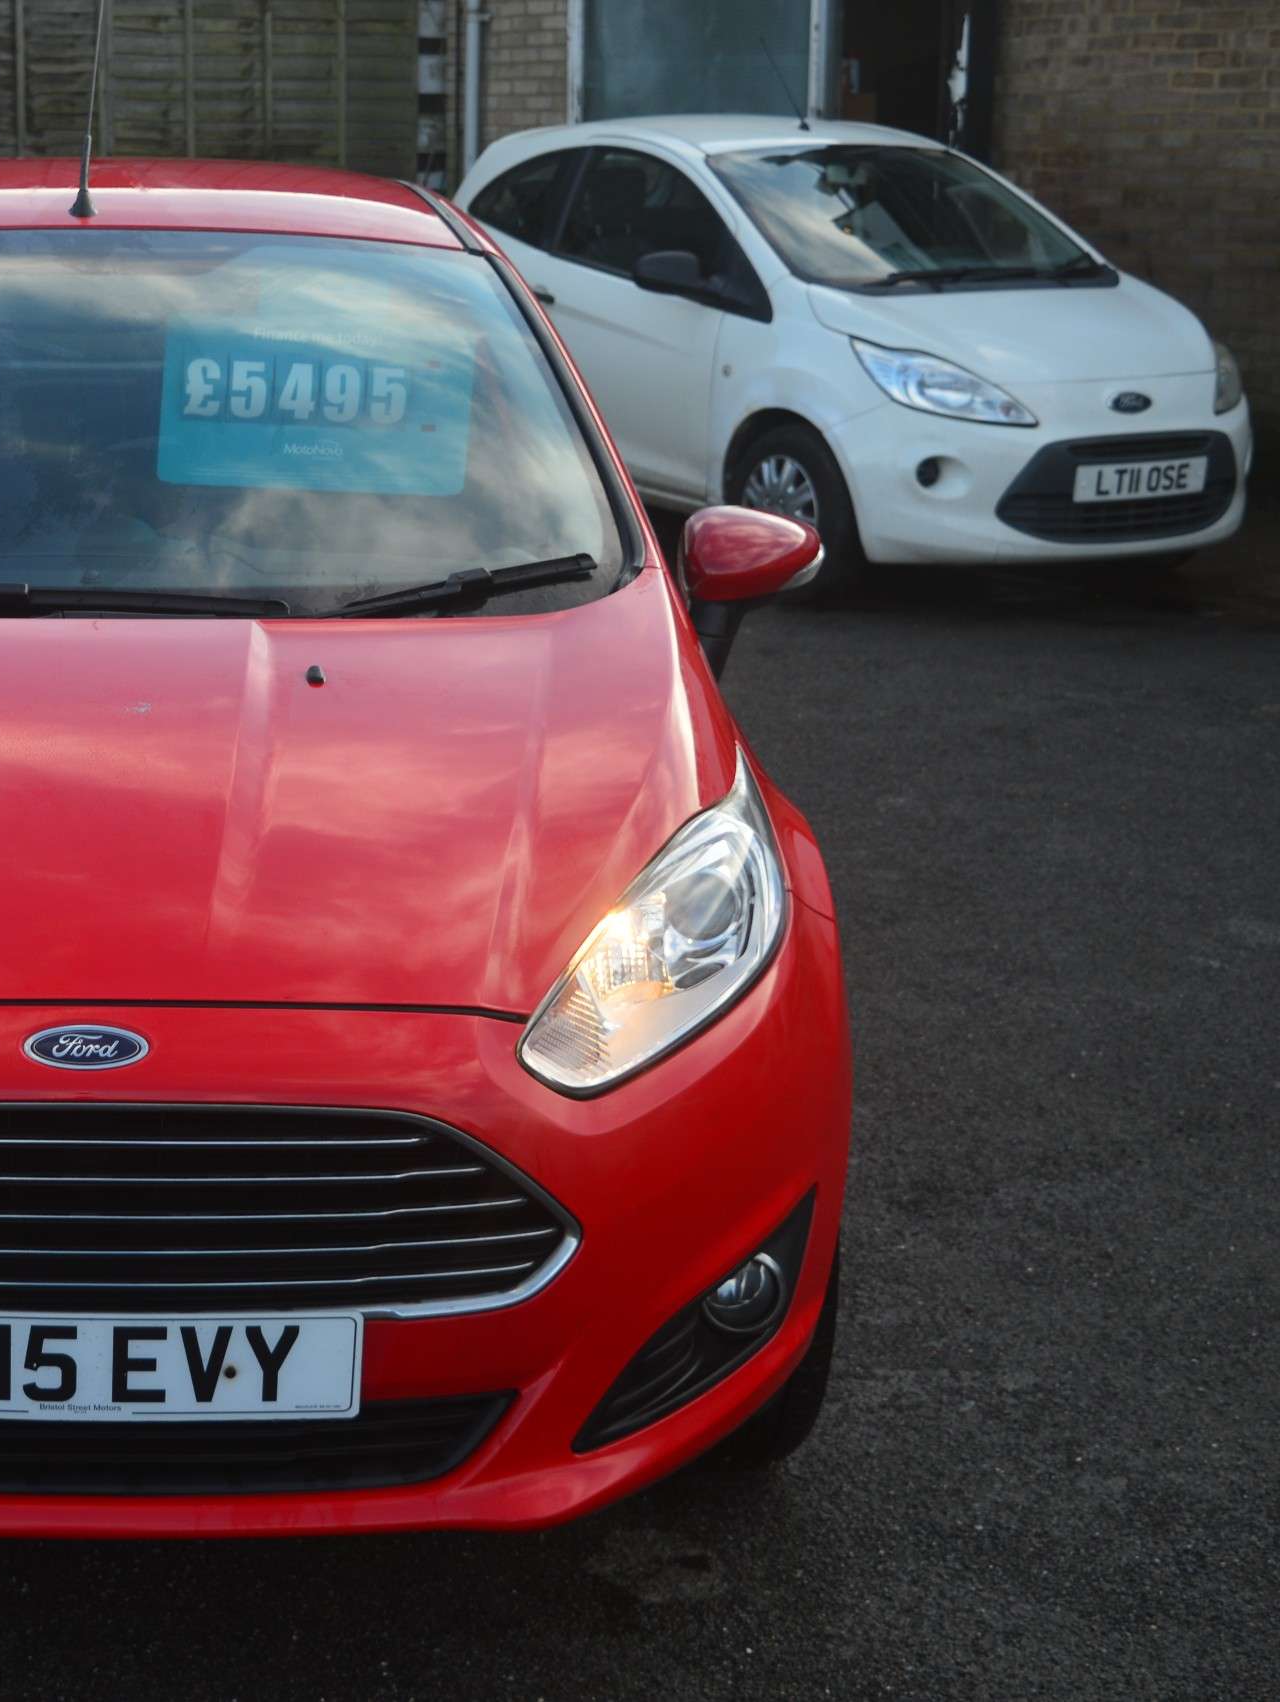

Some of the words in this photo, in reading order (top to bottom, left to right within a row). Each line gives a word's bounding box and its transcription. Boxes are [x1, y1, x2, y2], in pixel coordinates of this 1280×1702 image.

[183, 358, 407, 424] £5495
[1095, 467, 1141, 496] LT11
[1146, 463, 1190, 491] OSE
[52, 1033, 119, 1058] Ford
[112, 1325, 300, 1402] EVY
[40, 1403, 65, 1411] Bristol
[67, 1404, 91, 1412] Street
[93, 1404, 122, 1412] Motors
